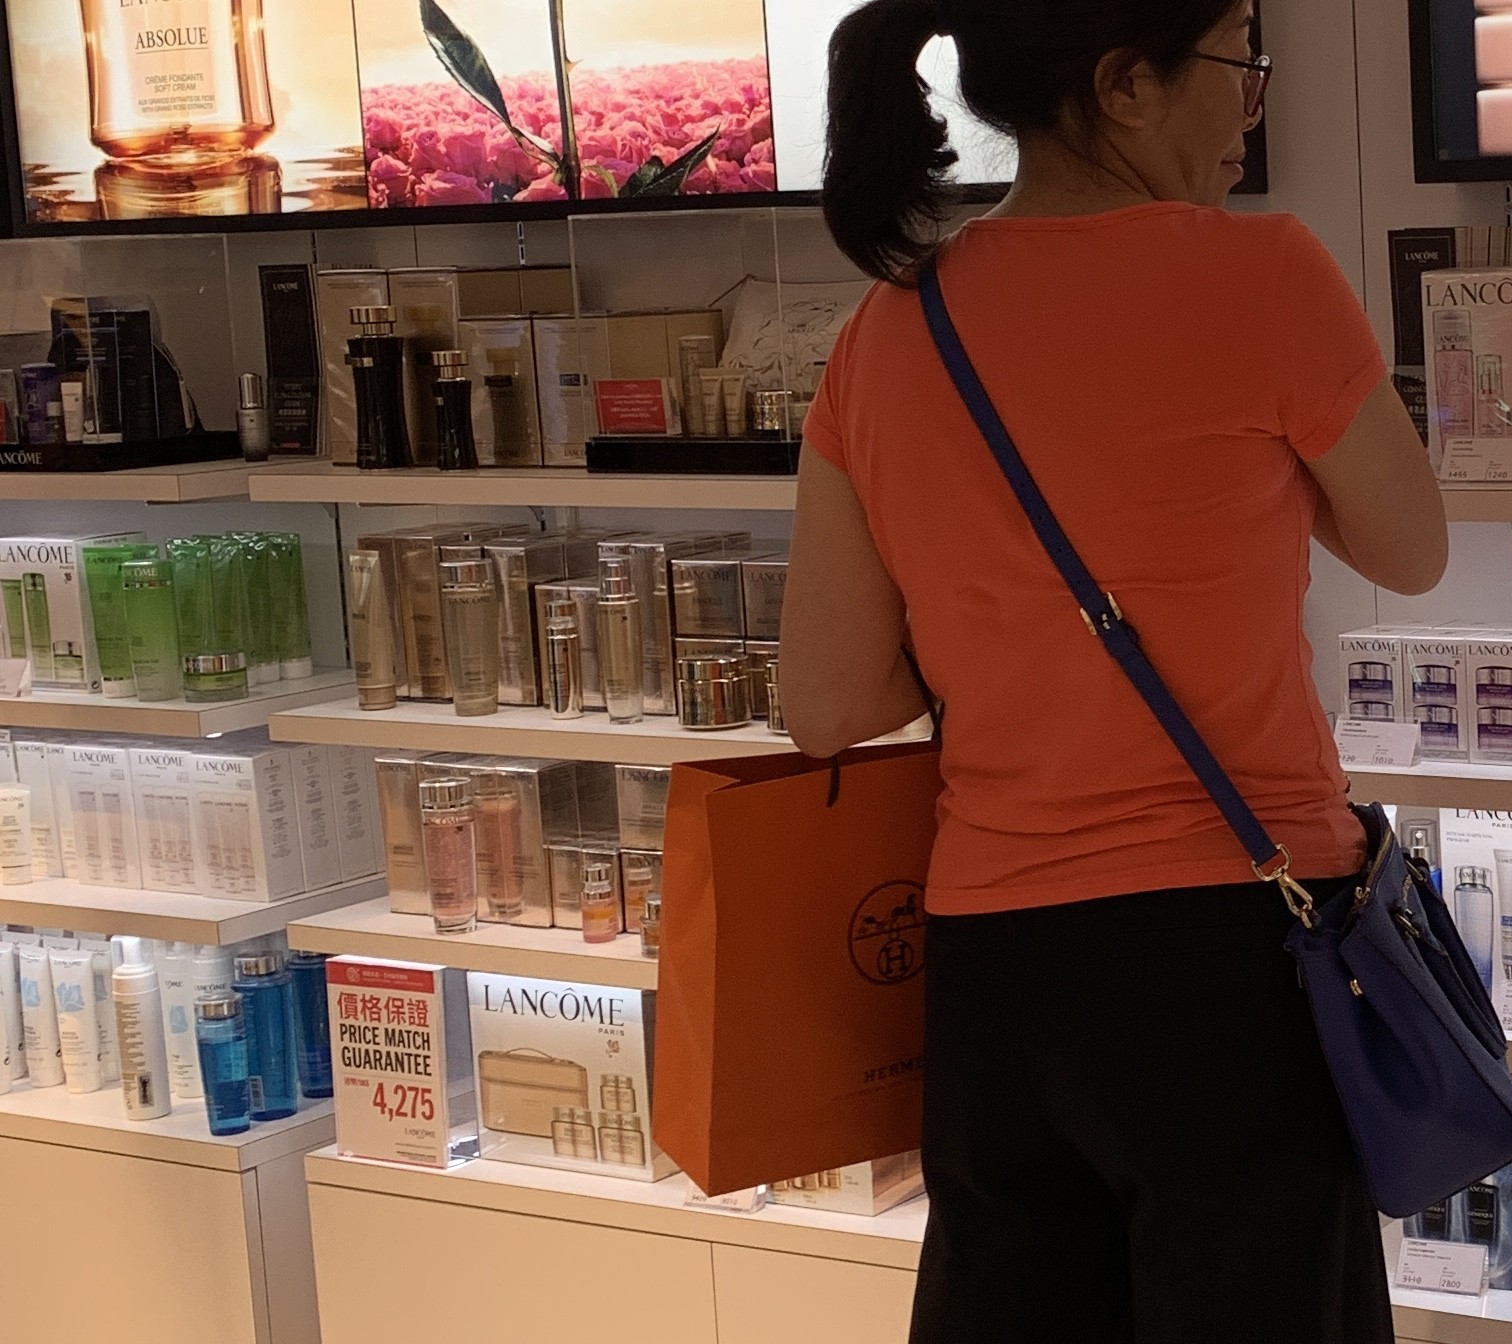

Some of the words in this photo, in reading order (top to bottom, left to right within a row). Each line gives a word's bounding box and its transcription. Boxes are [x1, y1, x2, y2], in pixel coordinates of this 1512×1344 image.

[135, 27, 208, 50] ABSOLUE
[0, 543, 75, 564] ANCÔME
[337, 992, 429, 1028] 價格保證
[484, 985, 625, 1027] LANCÔME
[339, 1023, 380, 1046] PRICE
[384, 1027, 430, 1051] MATCH
[599, 1028, 625, 1036] PARIS
[342, 1046, 432, 1076] GUARANTEE
[373, 1083, 434, 1122] 4,275
[1442, 1279, 1461, 1288] 2800
